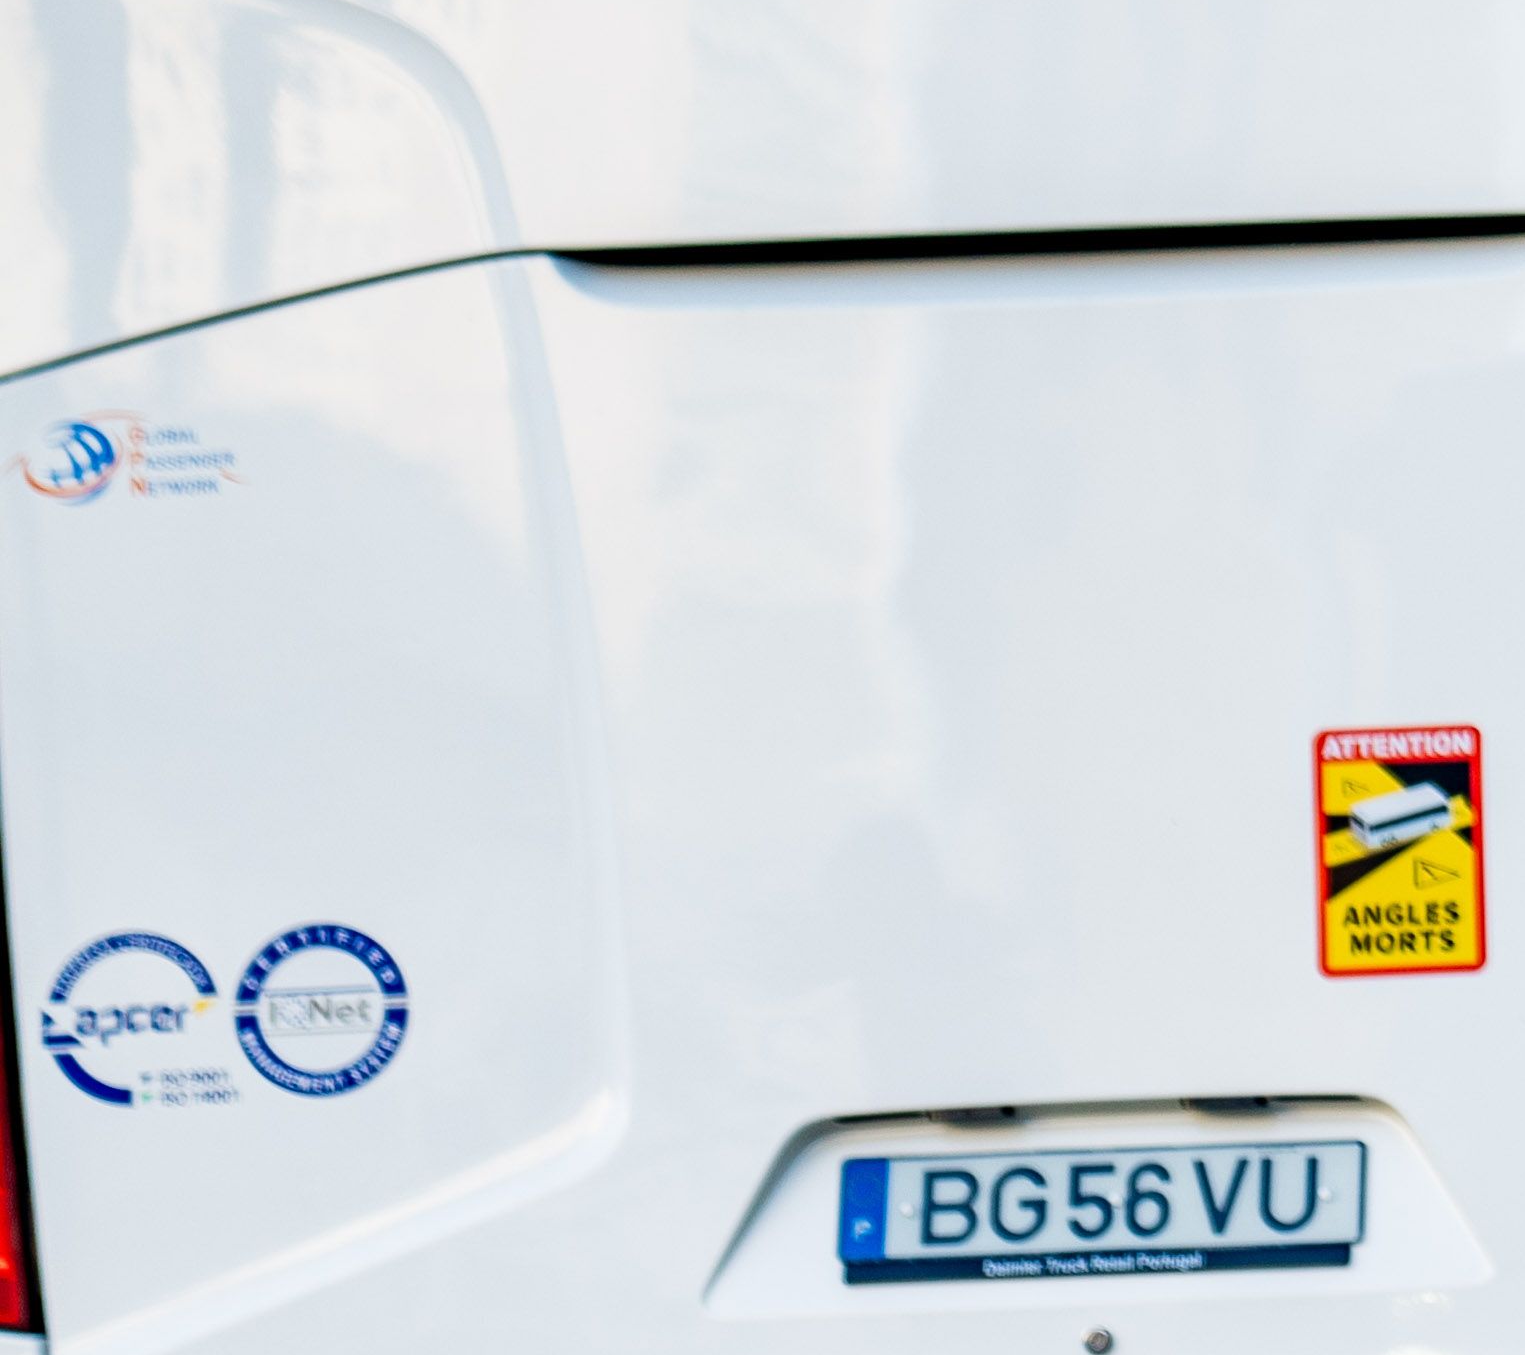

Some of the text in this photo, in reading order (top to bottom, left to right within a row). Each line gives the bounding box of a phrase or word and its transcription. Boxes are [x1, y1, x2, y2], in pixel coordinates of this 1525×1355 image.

[1320, 729, 1475, 761] ATTENTION
[1343, 899, 1462, 928] ANGLES
[1350, 929, 1457, 954] MORTS
